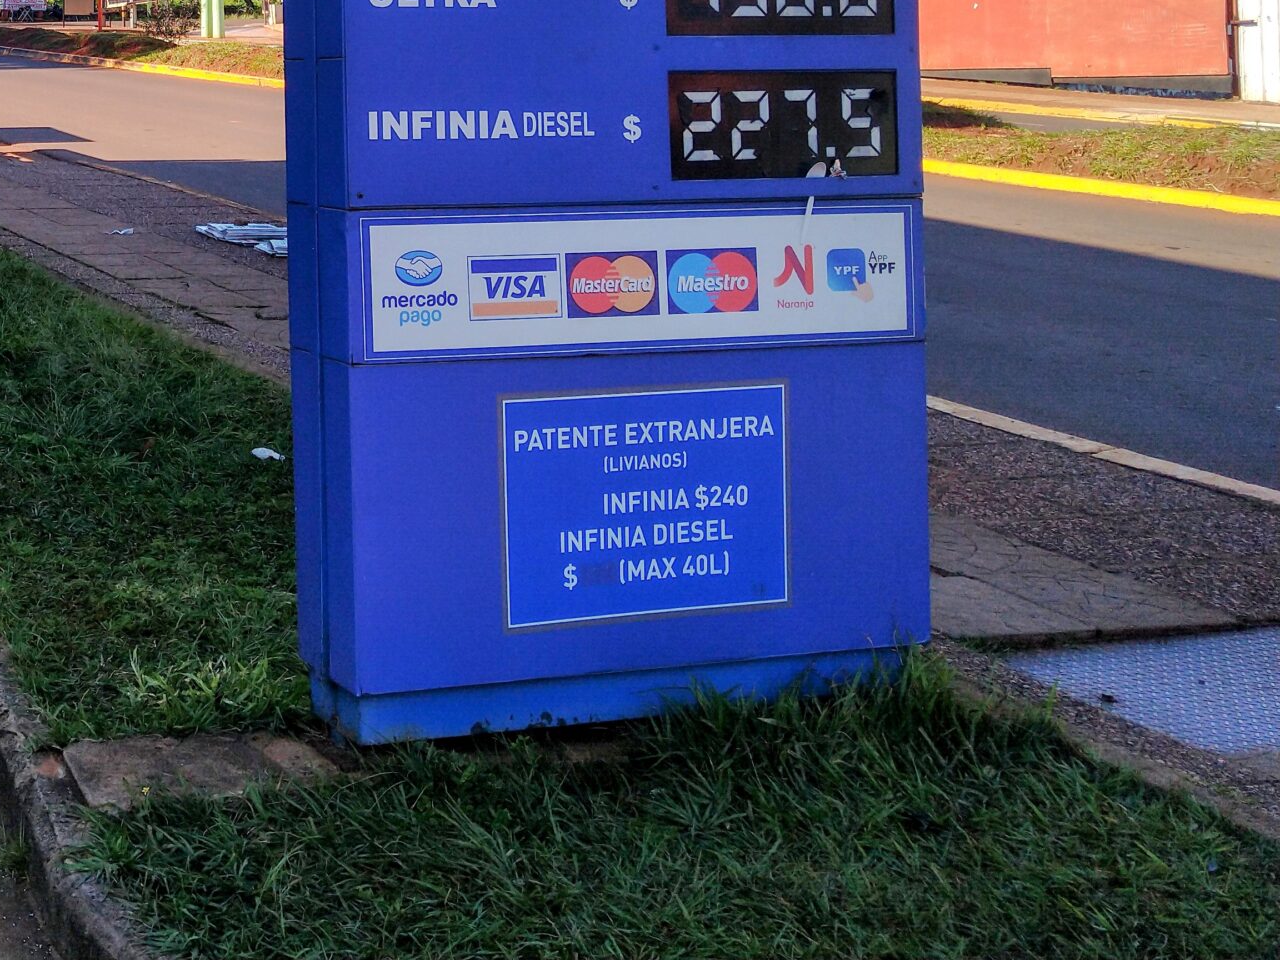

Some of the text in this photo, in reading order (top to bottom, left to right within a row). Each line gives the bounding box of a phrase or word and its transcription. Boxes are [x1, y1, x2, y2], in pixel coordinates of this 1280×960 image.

[368, 88, 881, 161] INFINIA DIESEL $ 227.5
[834, 266, 860, 275] YPF
[869, 262, 896, 274] YPF
[483, 275, 546, 299] VISA
[572, 274, 653, 294] MasterCard
[677, 275, 749, 292] Maestro
[381, 290, 458, 308] mercado
[777, 299, 814, 310] Naranja
[399, 307, 442, 326] pago
[514, 415, 774, 452] PATENTE EXTRANJERA
[603, 451, 687, 473] (LIVIANOS)
[603, 484, 748, 515] INFINIA $240
[560, 519, 733, 553] INFINIA DIESEL
[564, 551, 730, 590] $ (MAX 40L)
